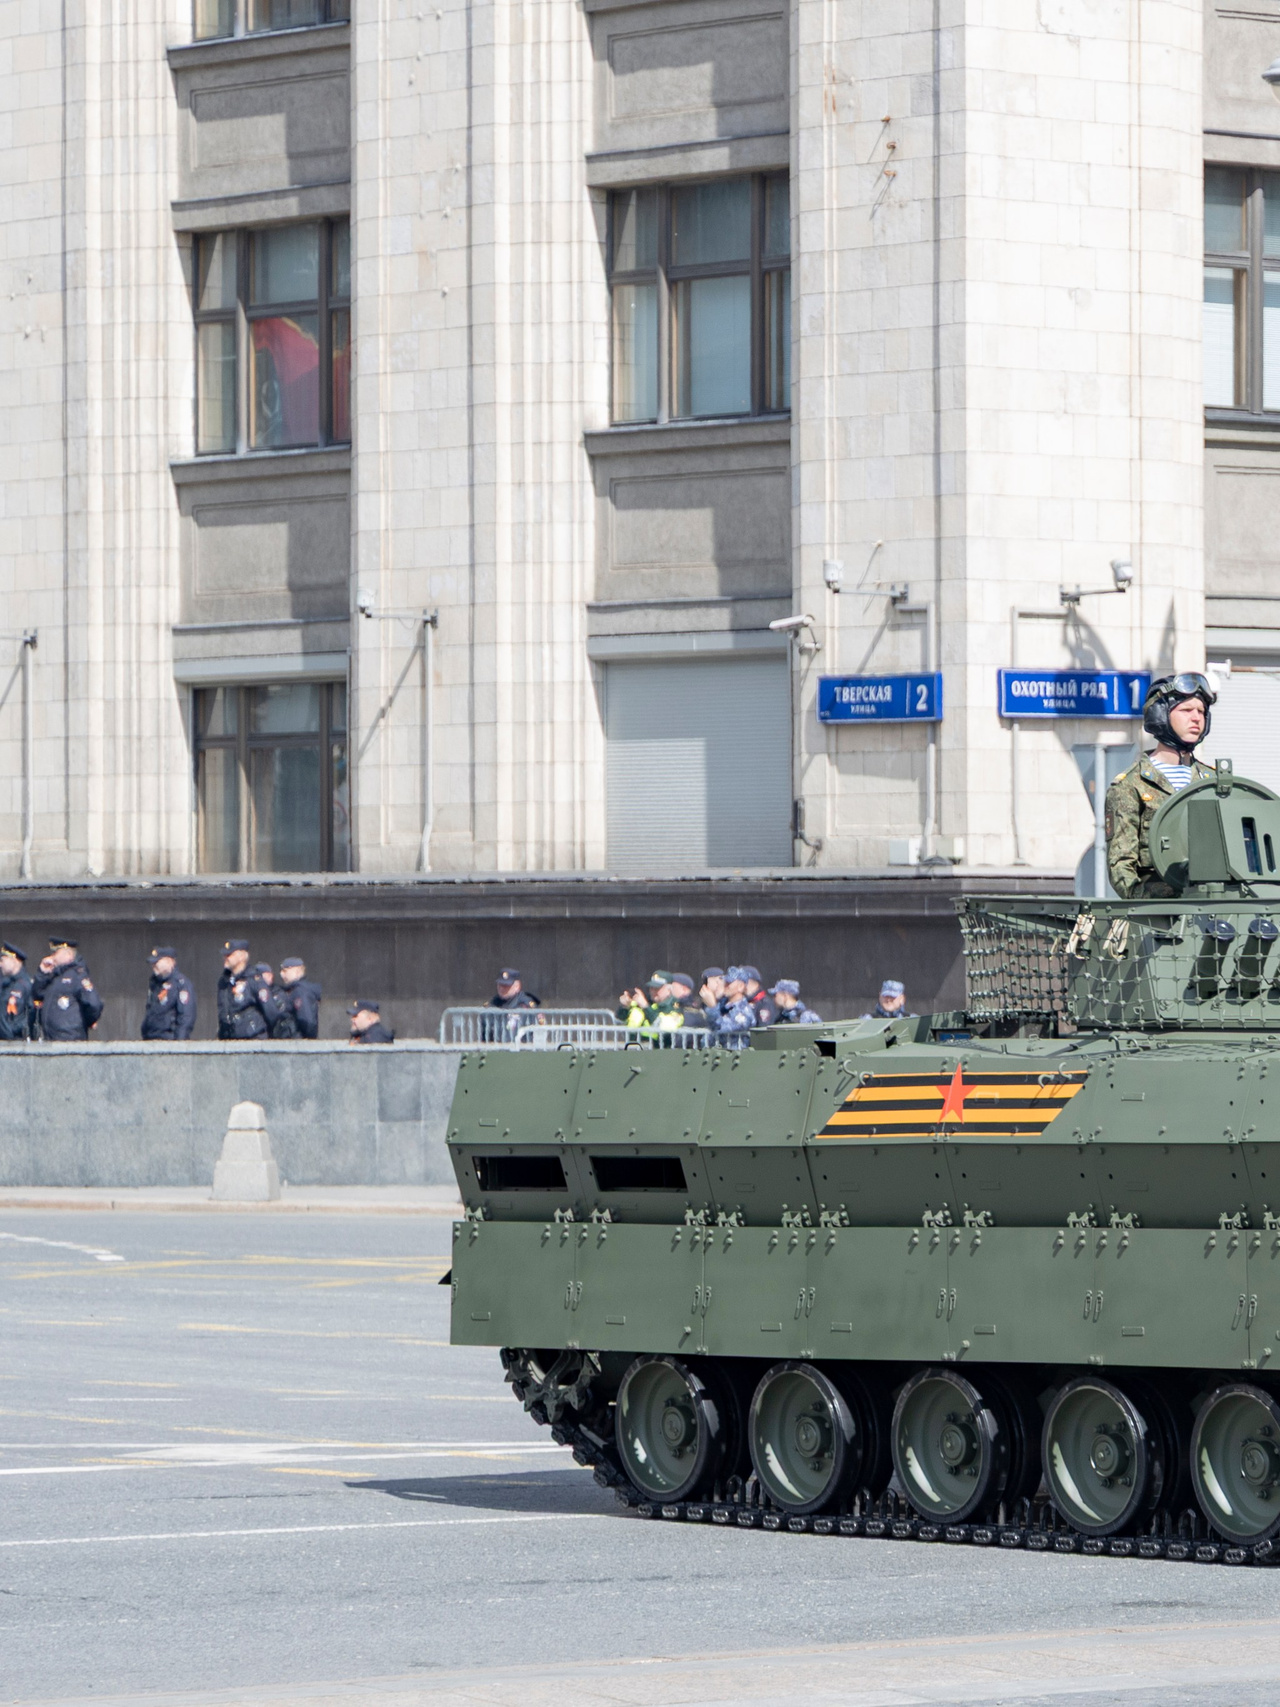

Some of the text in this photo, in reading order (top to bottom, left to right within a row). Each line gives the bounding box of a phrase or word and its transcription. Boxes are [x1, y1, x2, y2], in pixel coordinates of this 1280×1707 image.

[834, 684, 928, 711] ТВЕРСКАЯ 2
[1011, 679, 1140, 709] ОХОТНЫЙ РЯД 1
[850, 704, 876, 714] УЛИЦА
[1043, 699, 1076, 709] УЛИЦА
